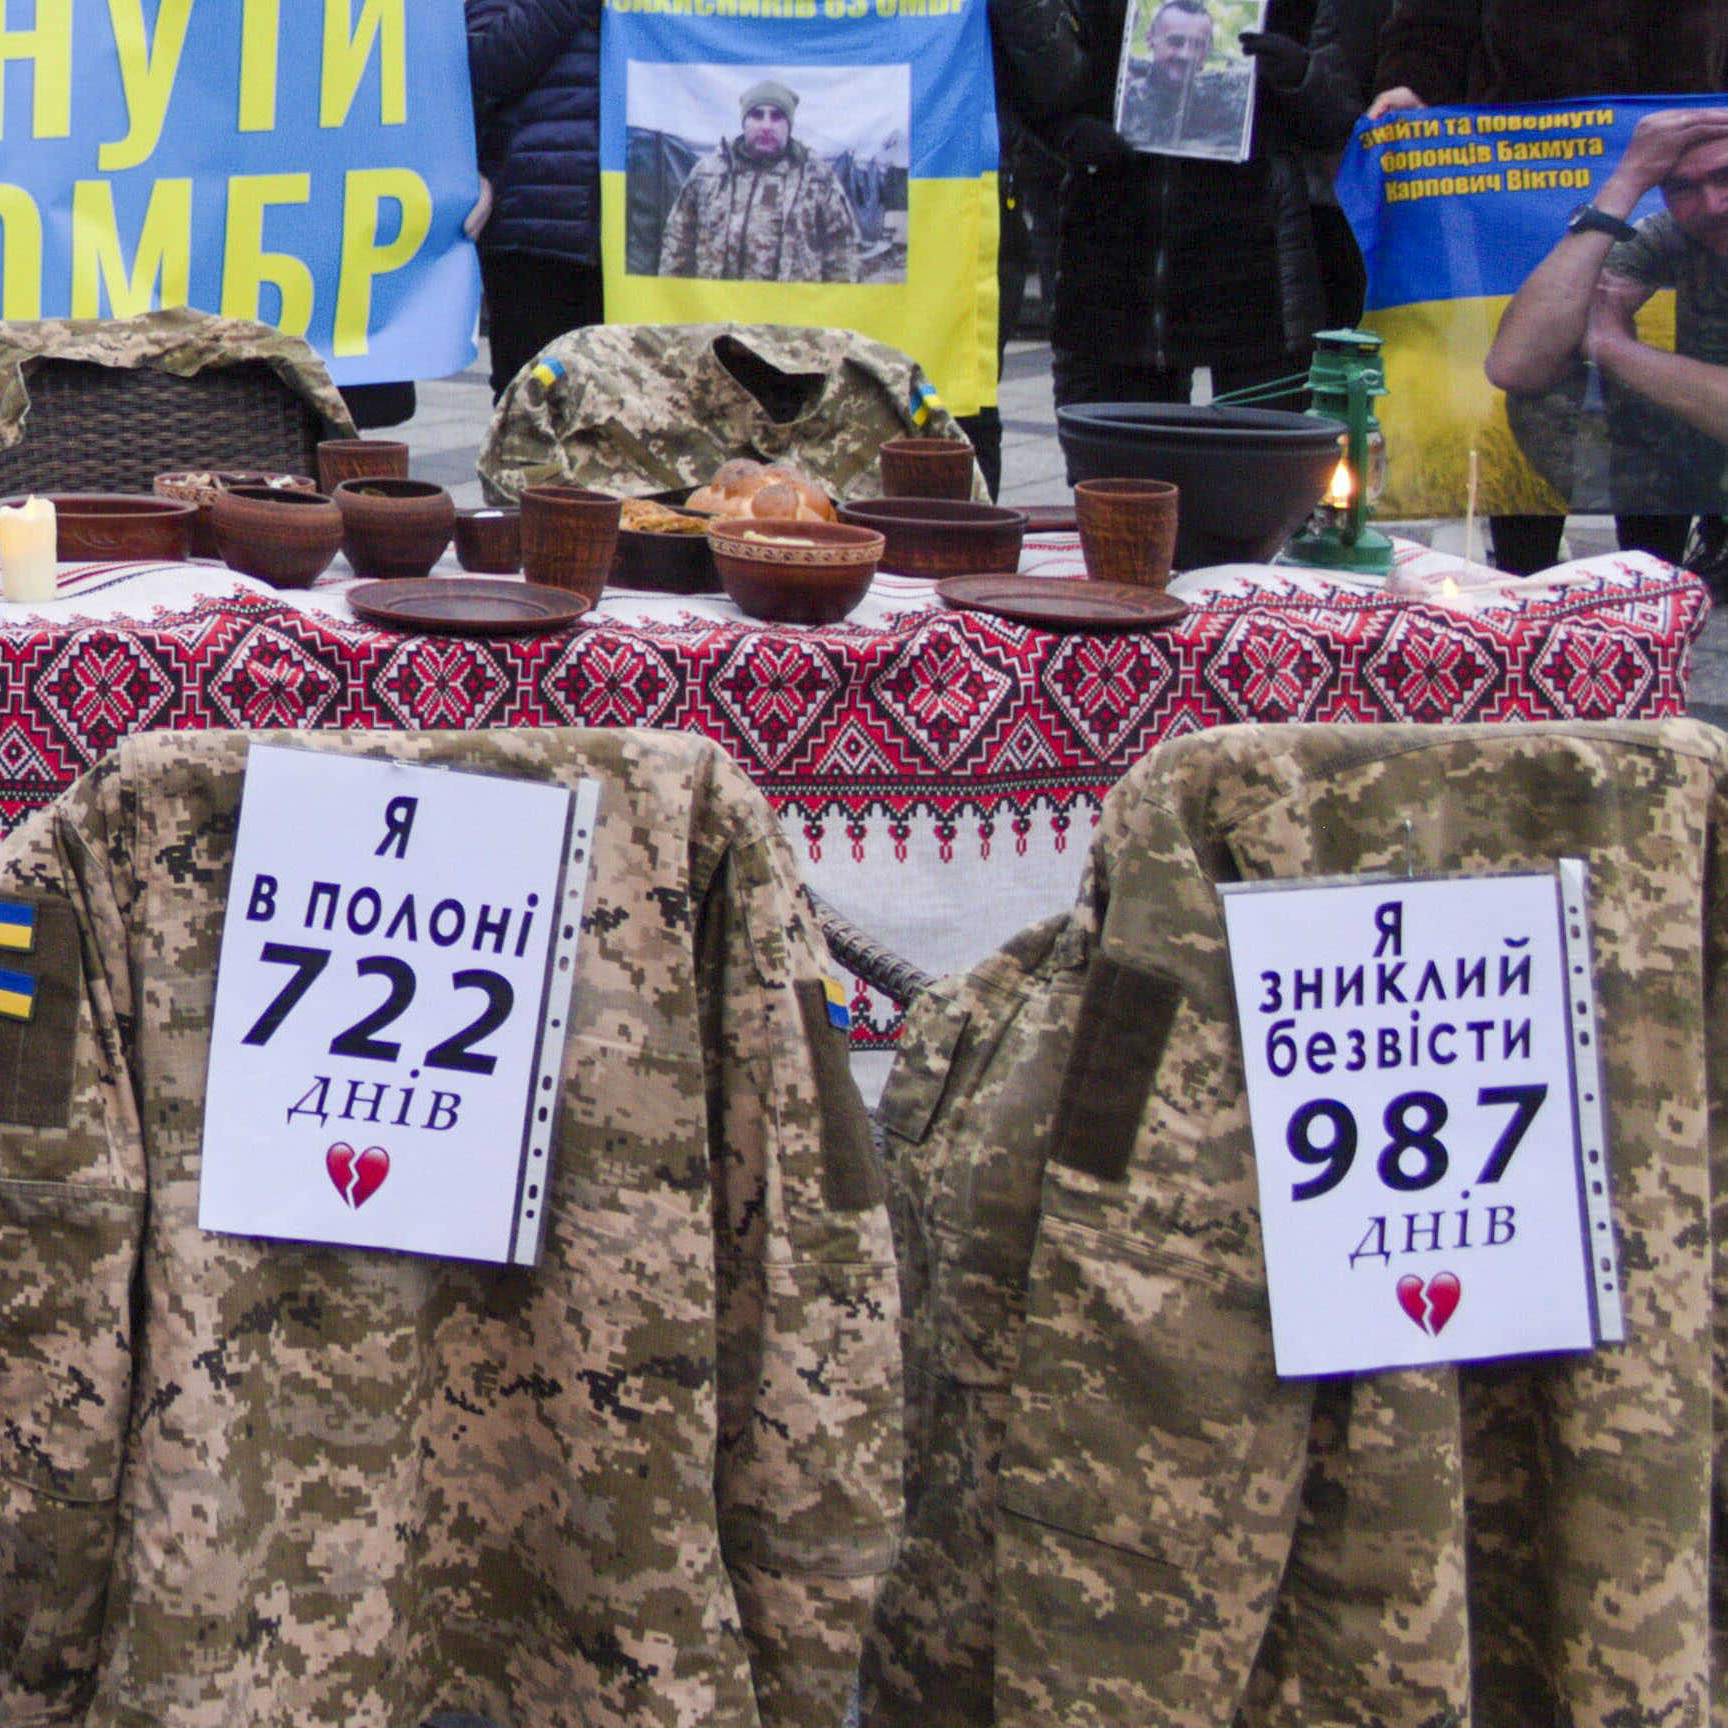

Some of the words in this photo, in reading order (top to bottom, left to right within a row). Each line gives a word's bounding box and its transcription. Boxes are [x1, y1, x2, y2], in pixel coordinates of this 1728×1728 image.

[1445, 116, 1474, 137] та
[1496, 137, 1605, 163] Бахмута
[1384, 173, 1502, 203] Карпович
[1506, 167, 1592, 192] Віктор
[374, 796, 419, 859] Я
[304, 893, 539, 958] полоні
[1373, 901, 1403, 958] Я
[1259, 937, 1531, 1014] зниклий
[241, 941, 515, 1076] 722
[1266, 1009, 1531, 1078] безвісти
[287, 1068, 462, 1131] днів
[1285, 1083, 1549, 1202] 987
[1349, 1189, 1516, 1270] днів
